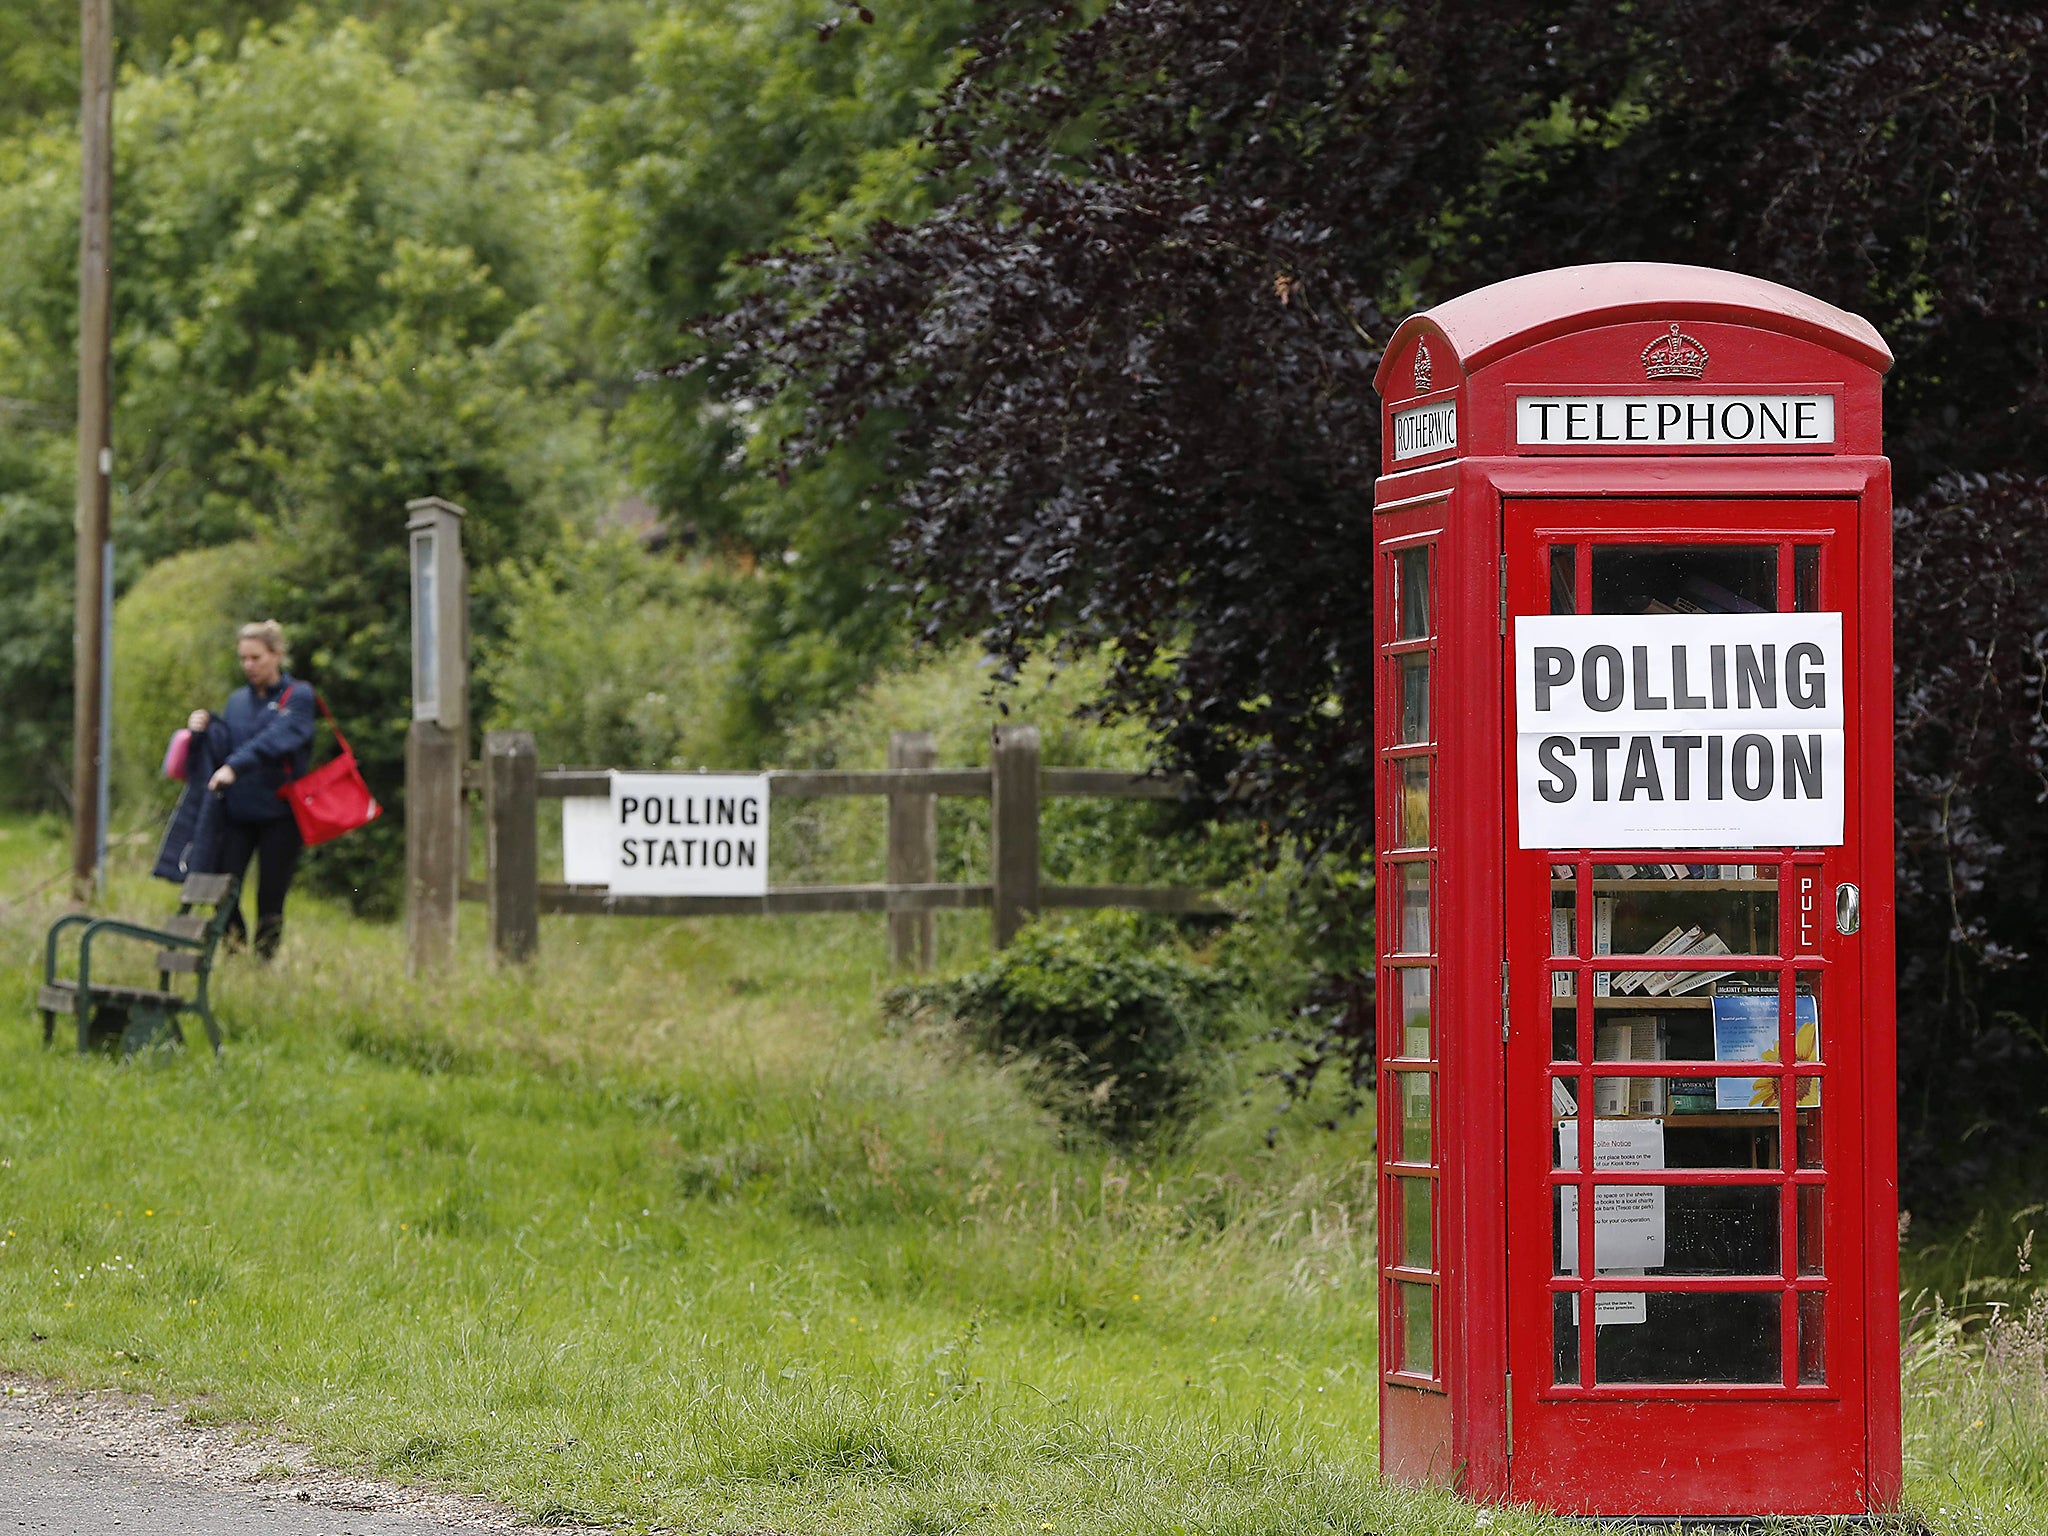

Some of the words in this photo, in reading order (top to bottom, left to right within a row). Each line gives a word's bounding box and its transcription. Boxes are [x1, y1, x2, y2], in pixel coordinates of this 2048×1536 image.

[1529, 401, 1819, 441] TELEPHONE
[1534, 642, 1826, 712] POLLING
[1538, 734, 1823, 803] STATION
[621, 797, 758, 825] POLLING
[621, 838, 756, 867] STATION
[1801, 878, 1812, 946] PULL
